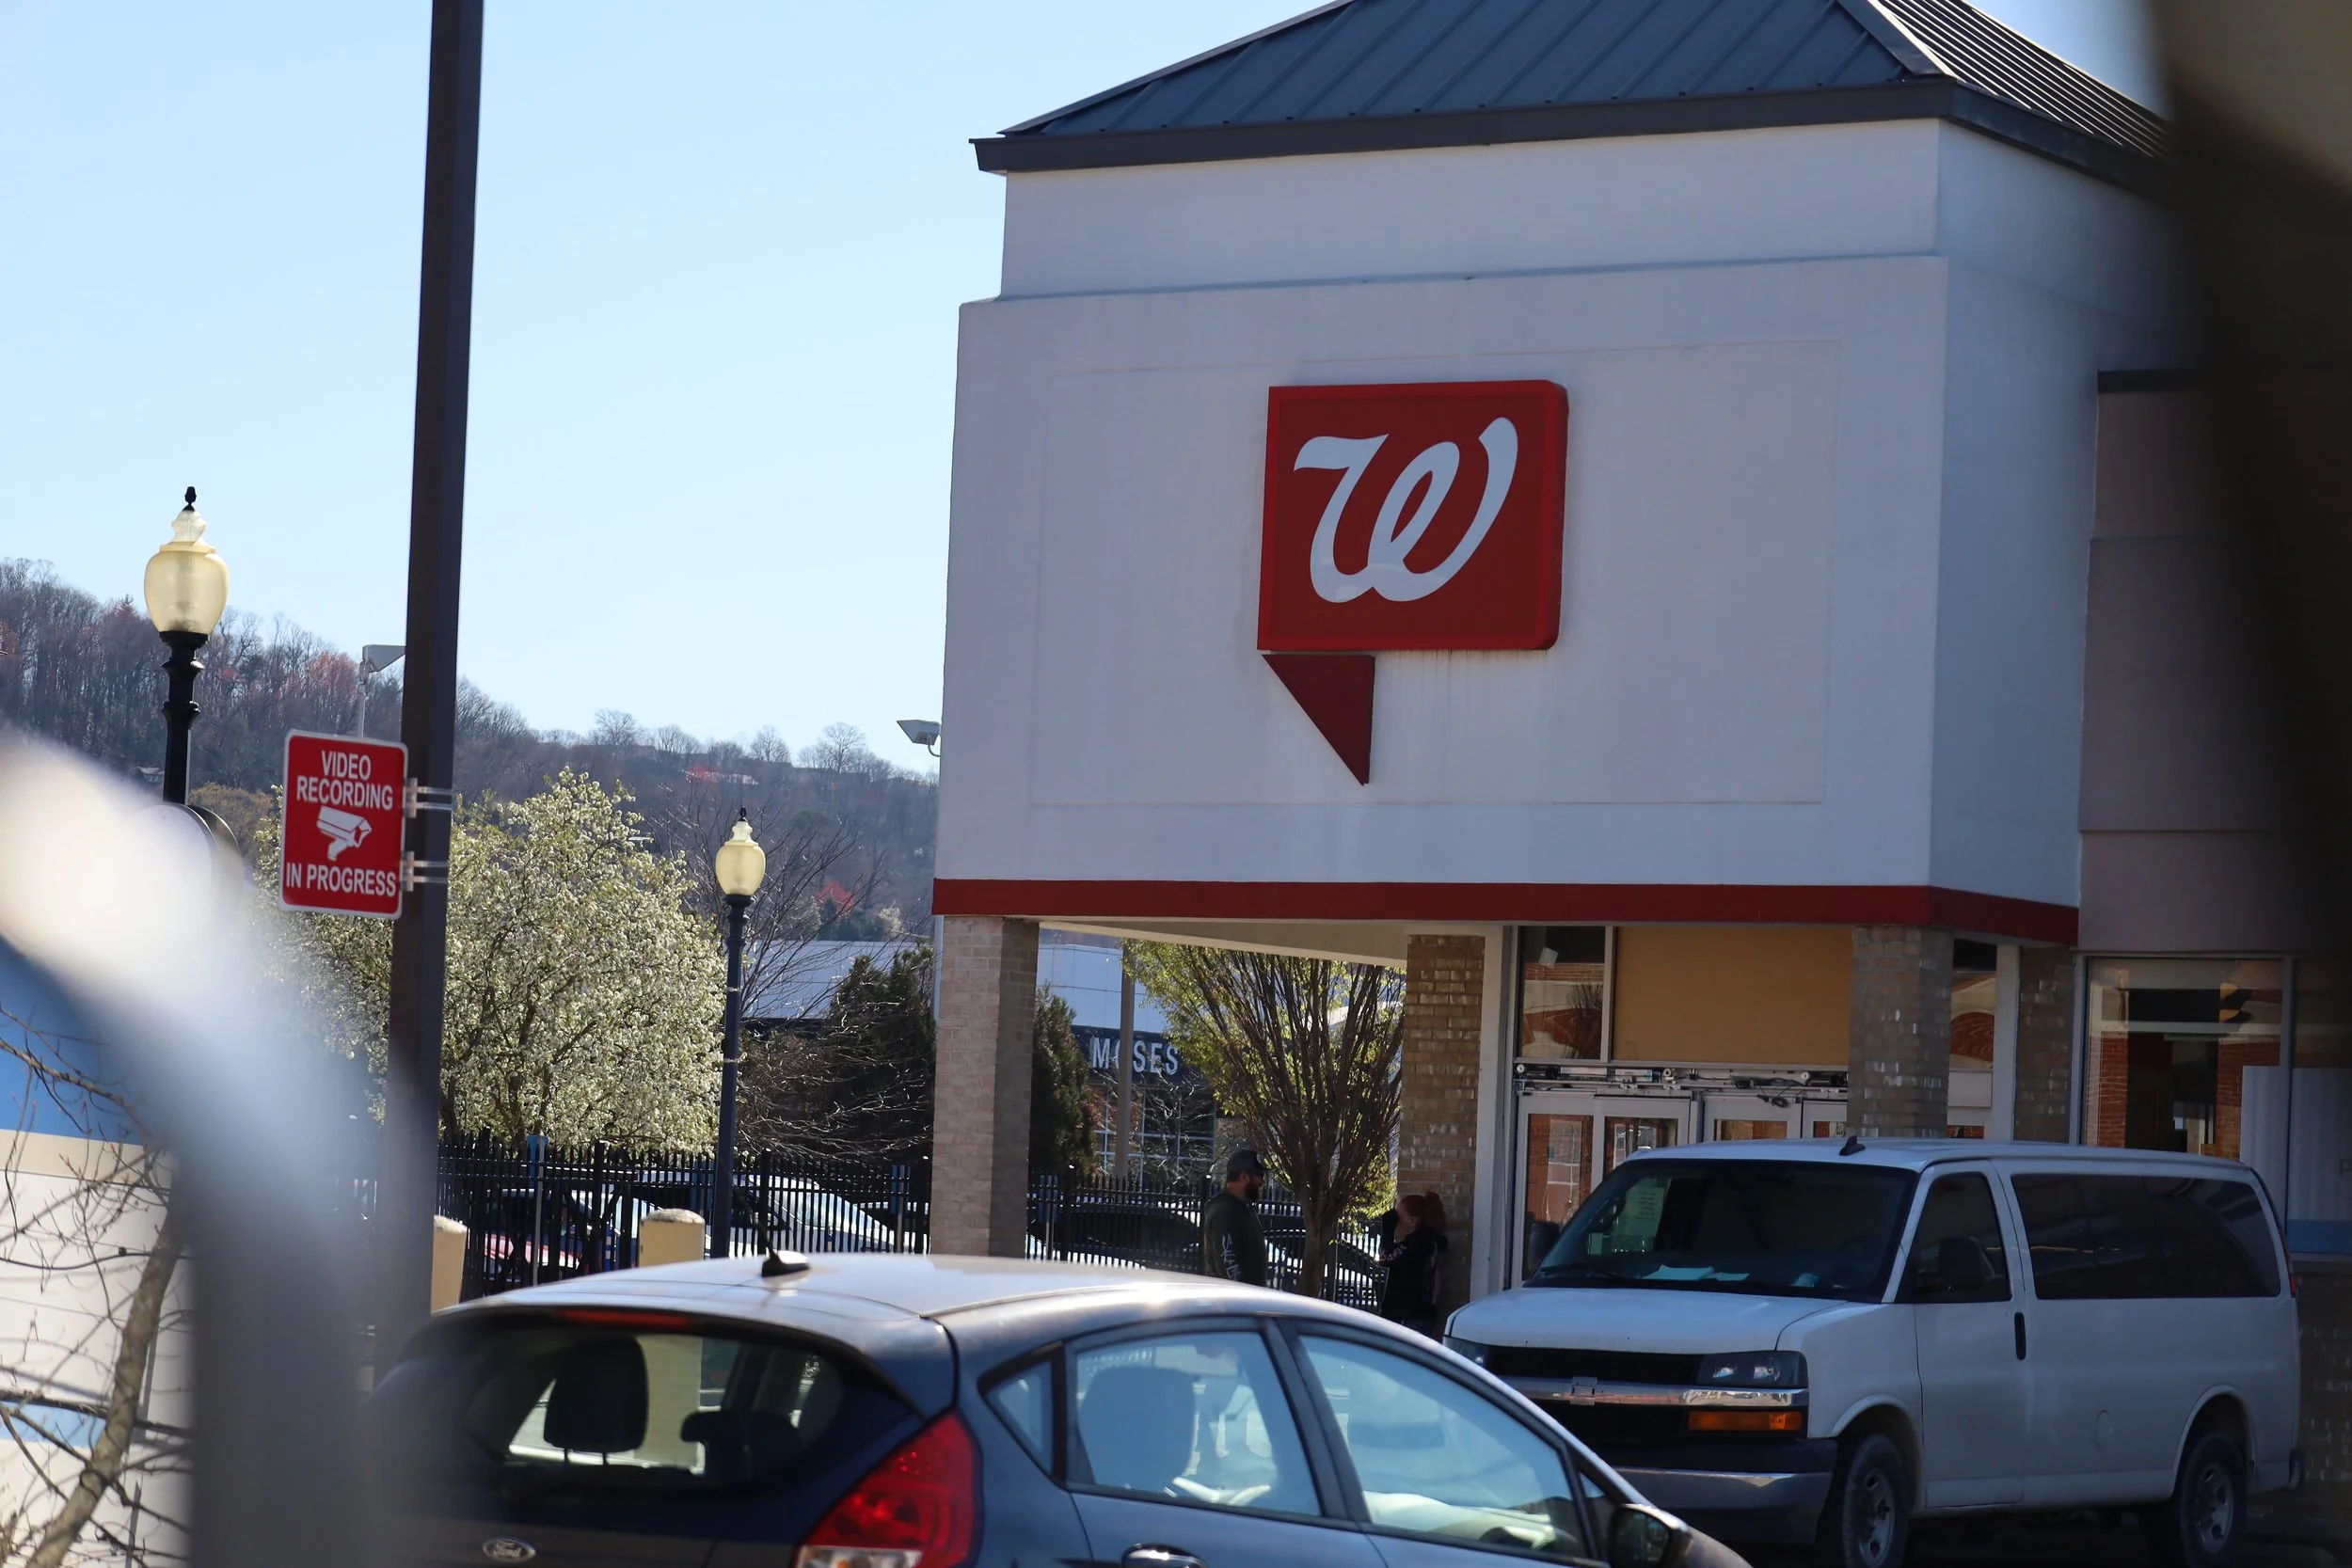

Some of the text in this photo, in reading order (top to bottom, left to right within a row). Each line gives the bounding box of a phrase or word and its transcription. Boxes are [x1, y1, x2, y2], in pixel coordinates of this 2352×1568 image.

[1294, 417, 1518, 603] W
[321, 750, 372, 781] VIDEO
[296, 775, 393, 811] RECORDING
[286, 862, 396, 897] IN PROGRESS
